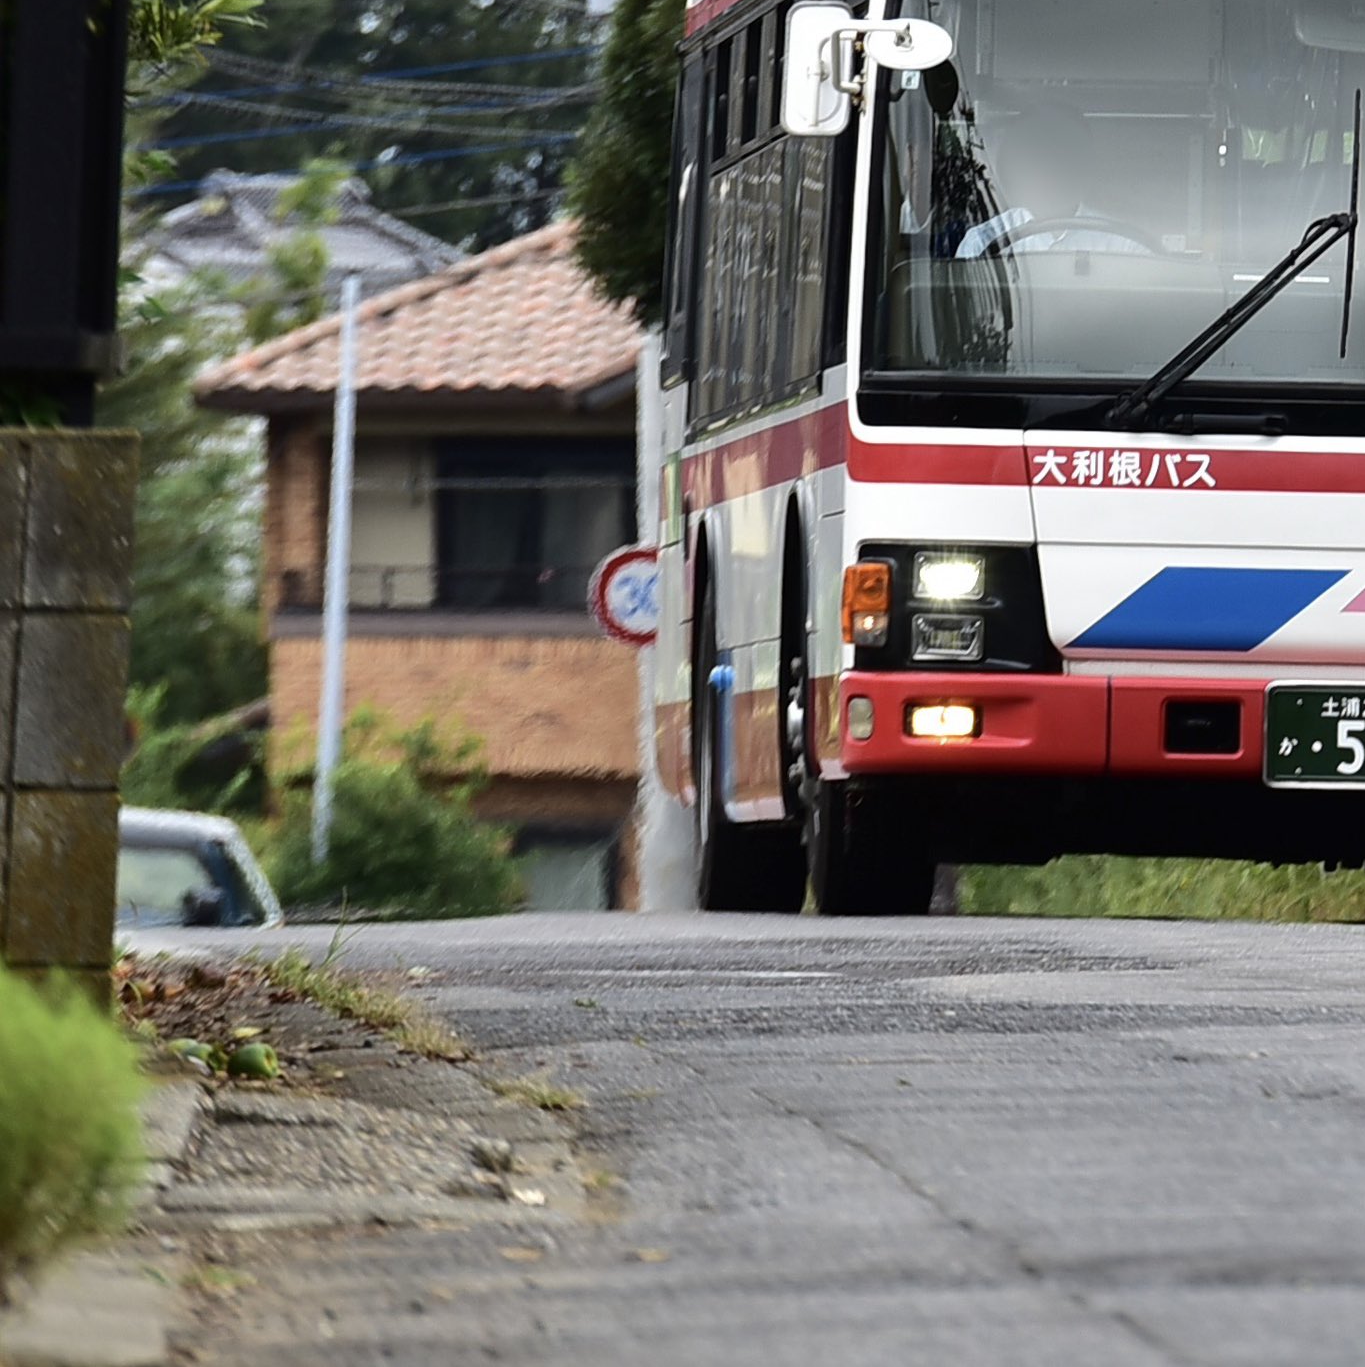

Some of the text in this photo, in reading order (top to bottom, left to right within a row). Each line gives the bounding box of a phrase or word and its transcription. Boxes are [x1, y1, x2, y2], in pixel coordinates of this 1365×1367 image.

[1032, 449, 1217, 488] 大利根バス
